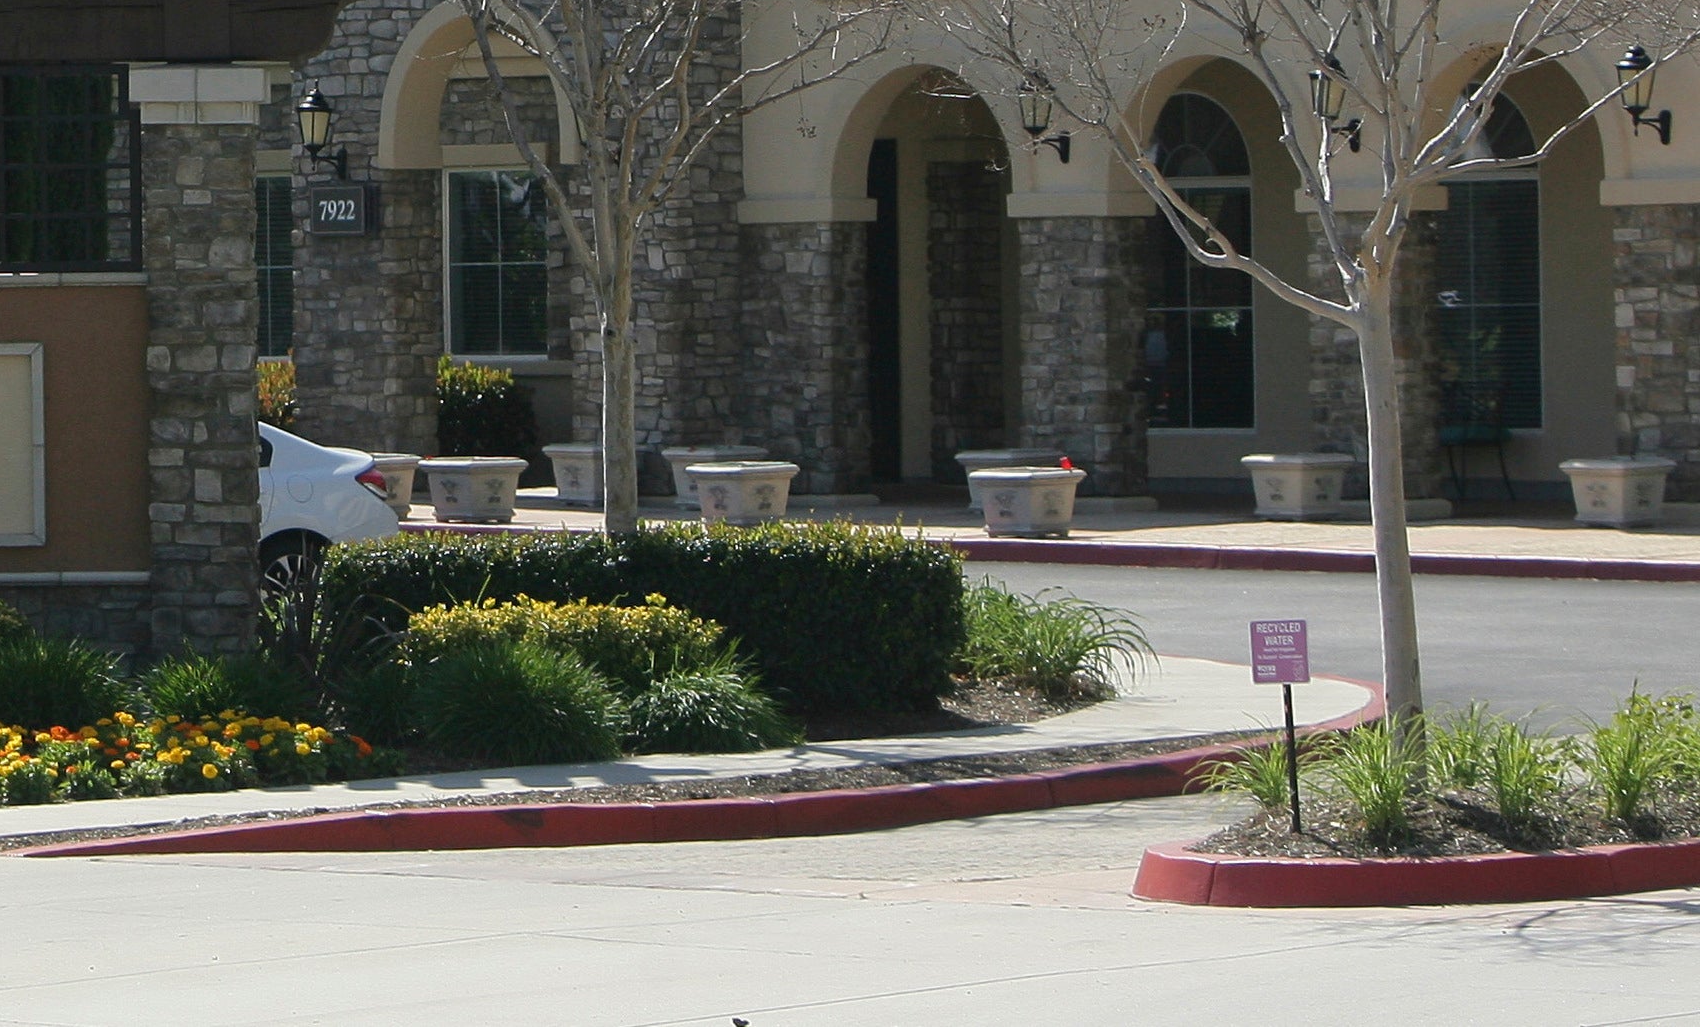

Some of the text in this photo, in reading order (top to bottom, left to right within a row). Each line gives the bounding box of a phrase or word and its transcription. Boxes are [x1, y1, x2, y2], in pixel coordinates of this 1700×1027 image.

[319, 200, 356, 221] 7922
[1256, 622, 1301, 633] RECYCLED
[1264, 635, 1294, 646] WATER
